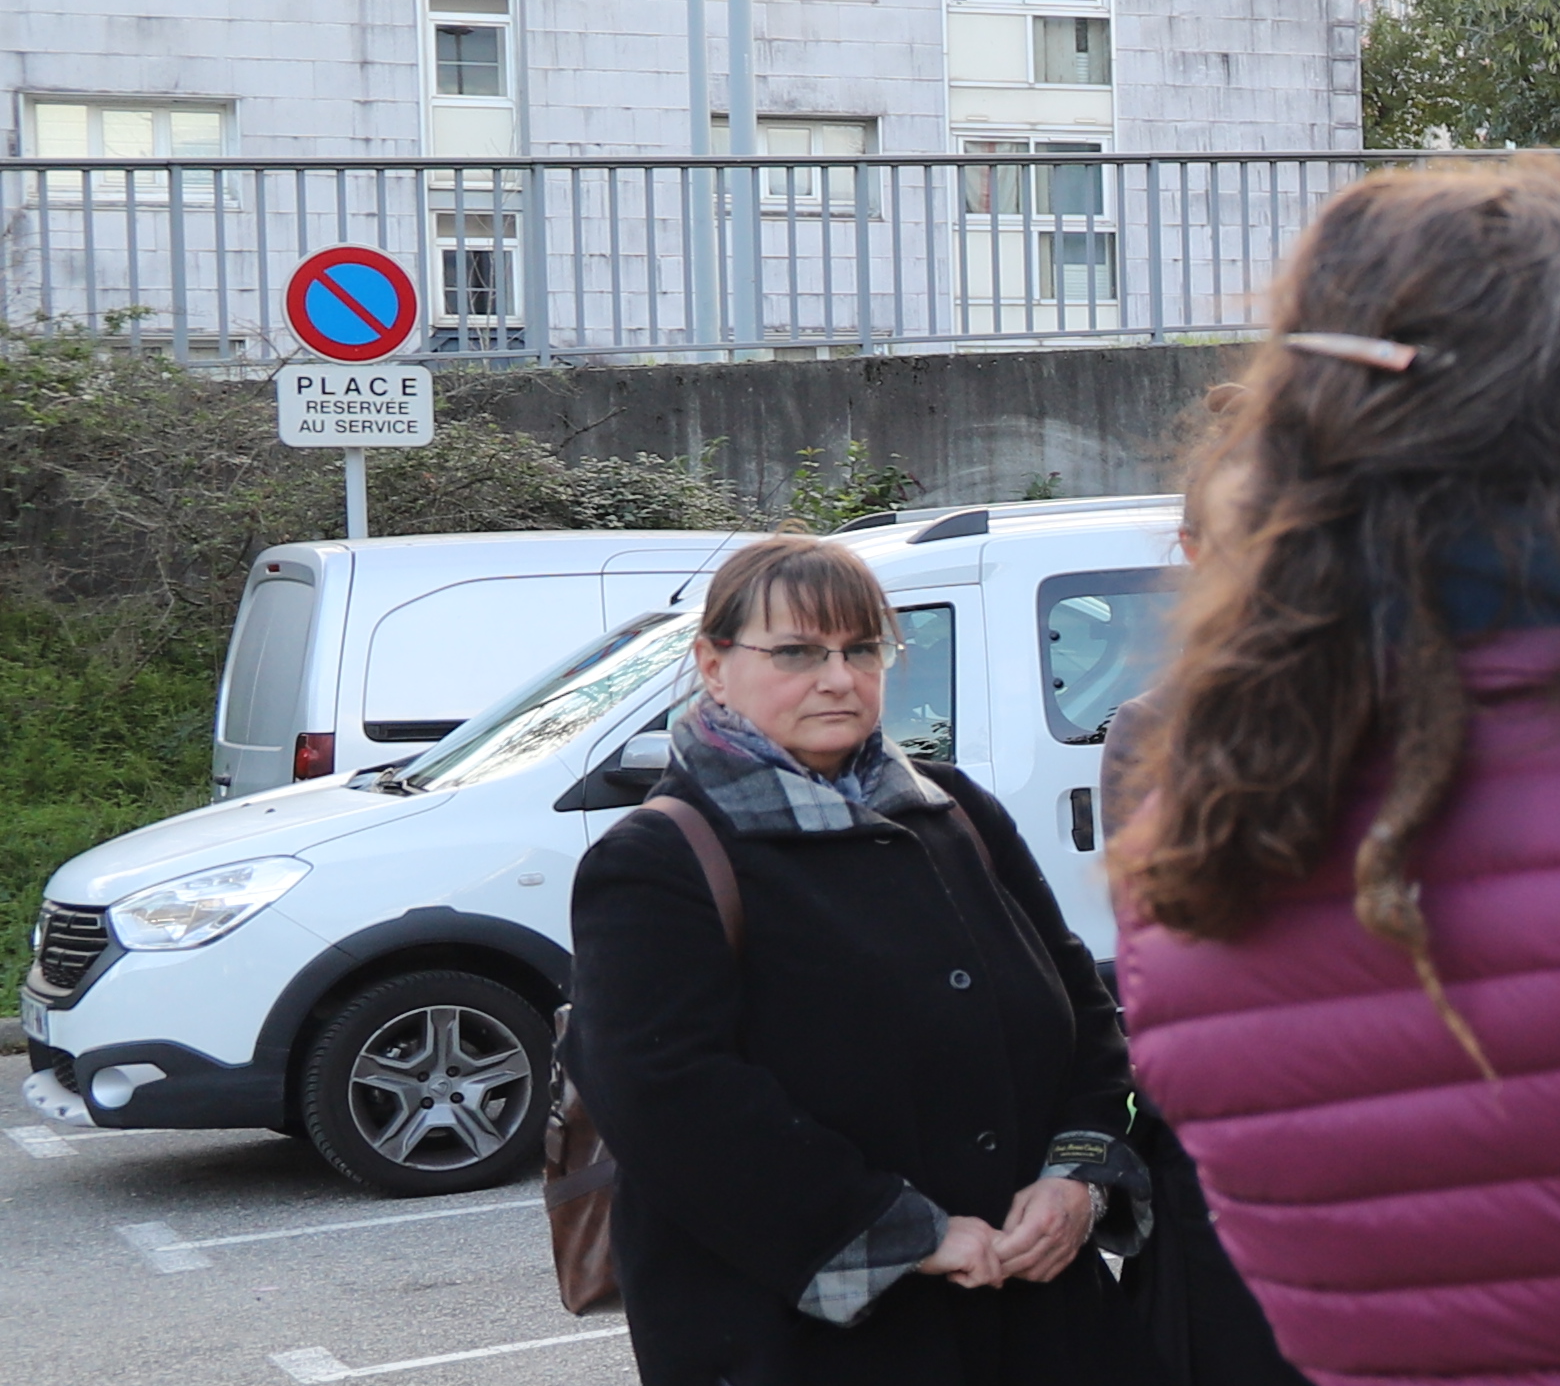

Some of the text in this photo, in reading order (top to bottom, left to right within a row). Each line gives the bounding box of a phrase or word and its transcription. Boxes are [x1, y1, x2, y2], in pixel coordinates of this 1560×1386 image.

[296, 376, 418, 396] PLACE
[305, 397, 410, 415] RESERVÉE
[298, 419, 419, 434] AU SERVICE
